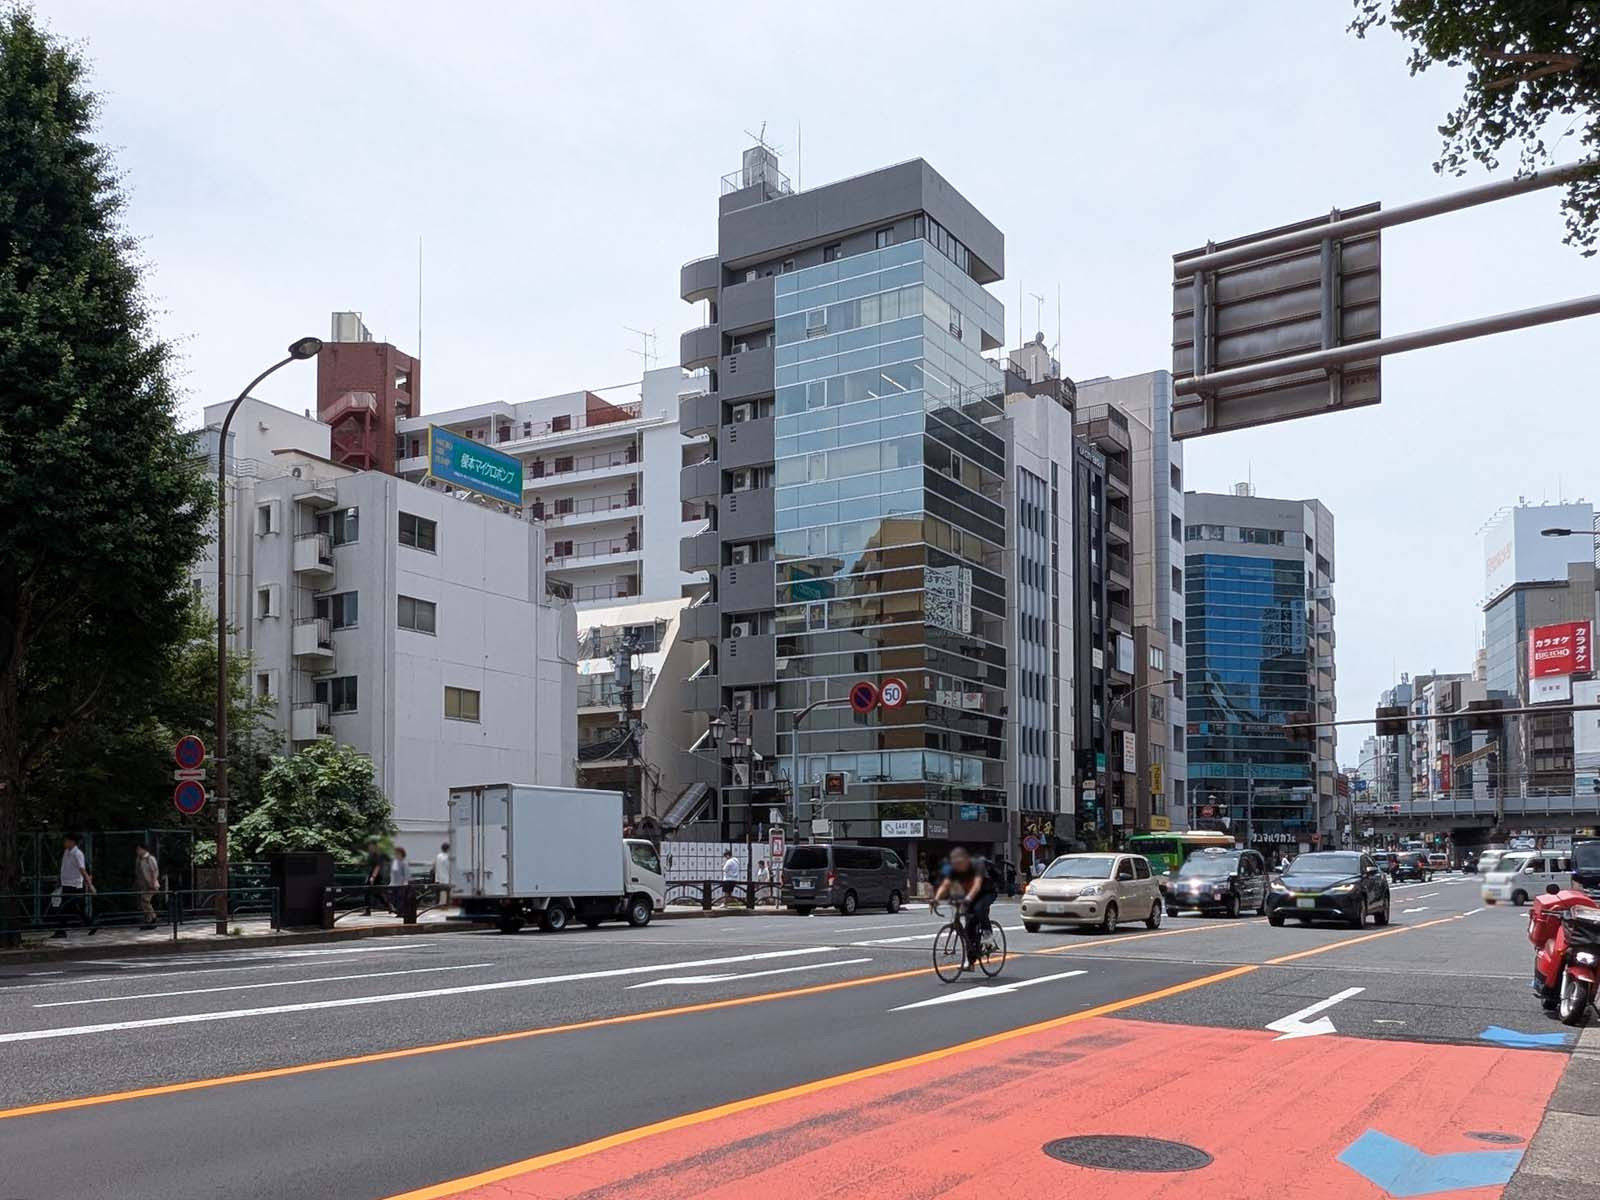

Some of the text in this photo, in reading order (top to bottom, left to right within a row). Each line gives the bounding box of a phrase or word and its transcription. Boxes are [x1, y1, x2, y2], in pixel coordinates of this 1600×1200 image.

[1535, 636, 1570, 648] カラオケ
[1575, 627, 1586, 663] カラオケ
[885, 687, 900, 702] 50
